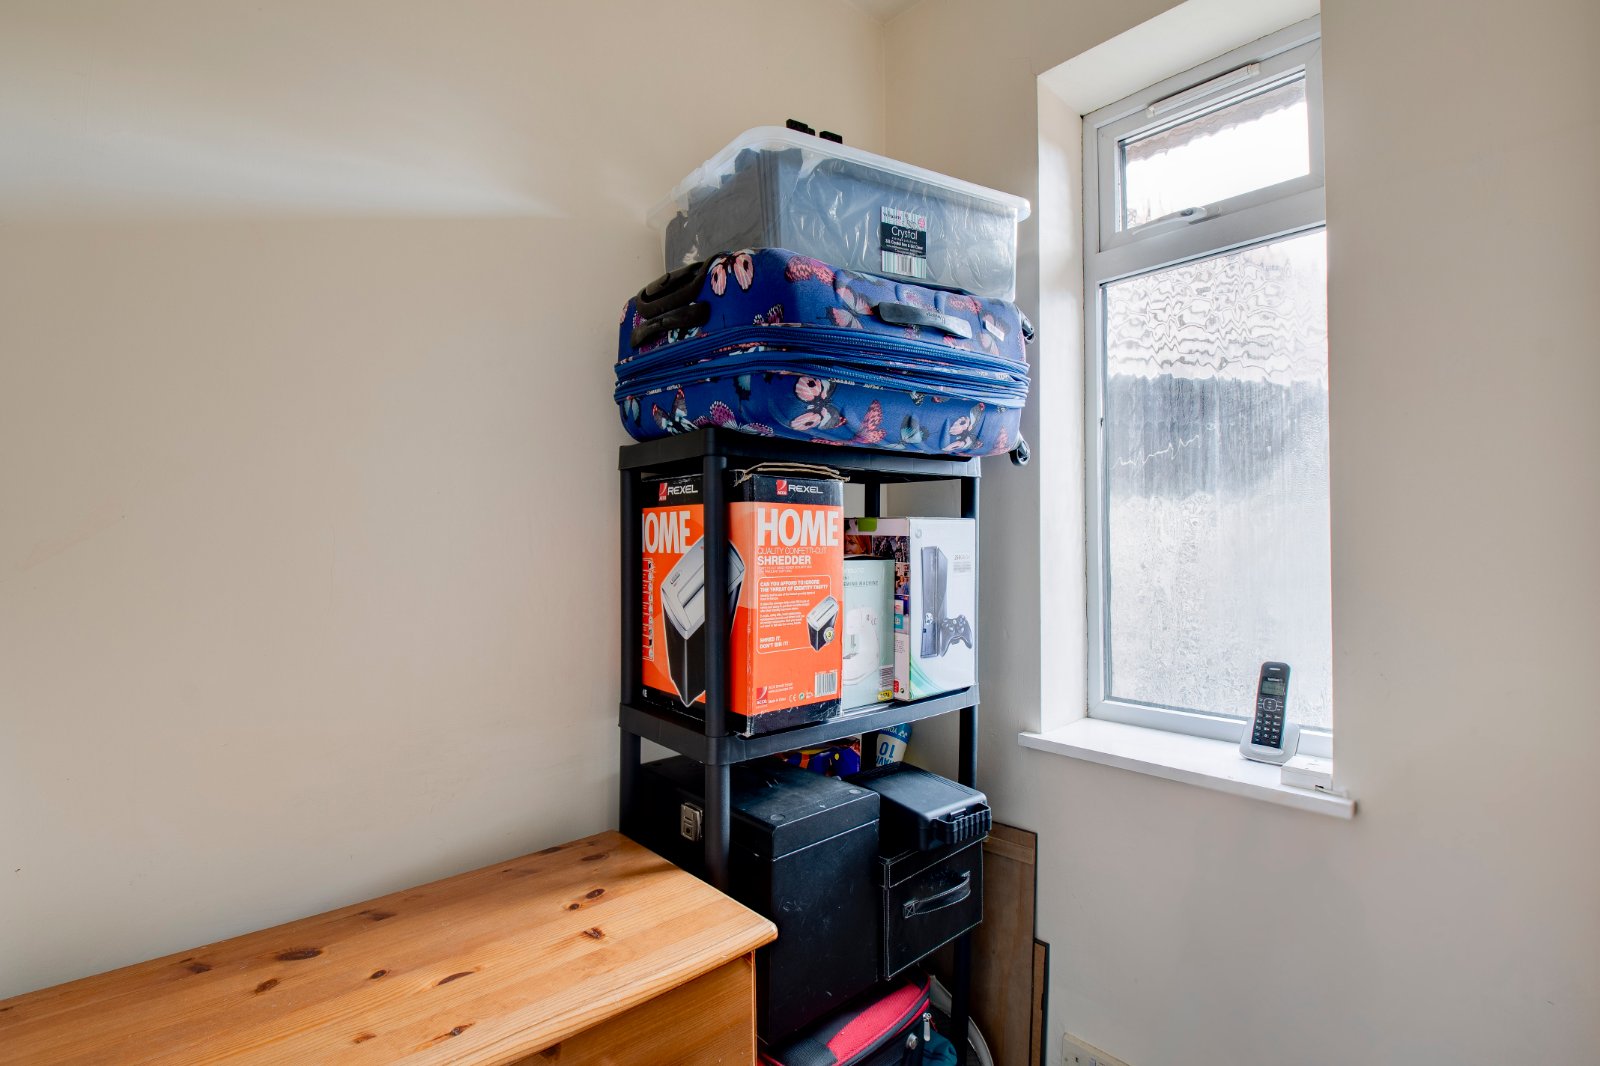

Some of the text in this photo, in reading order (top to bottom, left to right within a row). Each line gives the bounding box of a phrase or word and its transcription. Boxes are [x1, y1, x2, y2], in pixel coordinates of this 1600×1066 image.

[891, 226, 918, 240] Crystal
[667, 484, 698, 495] REXEL
[788, 484, 824, 494] REXEL
[642, 511, 692, 554] OME
[757, 508, 839, 547] HOME
[757, 547, 783, 555] QUALITY
[757, 555, 811, 566] SHREDDER
[879, 741, 896, 758] 10
